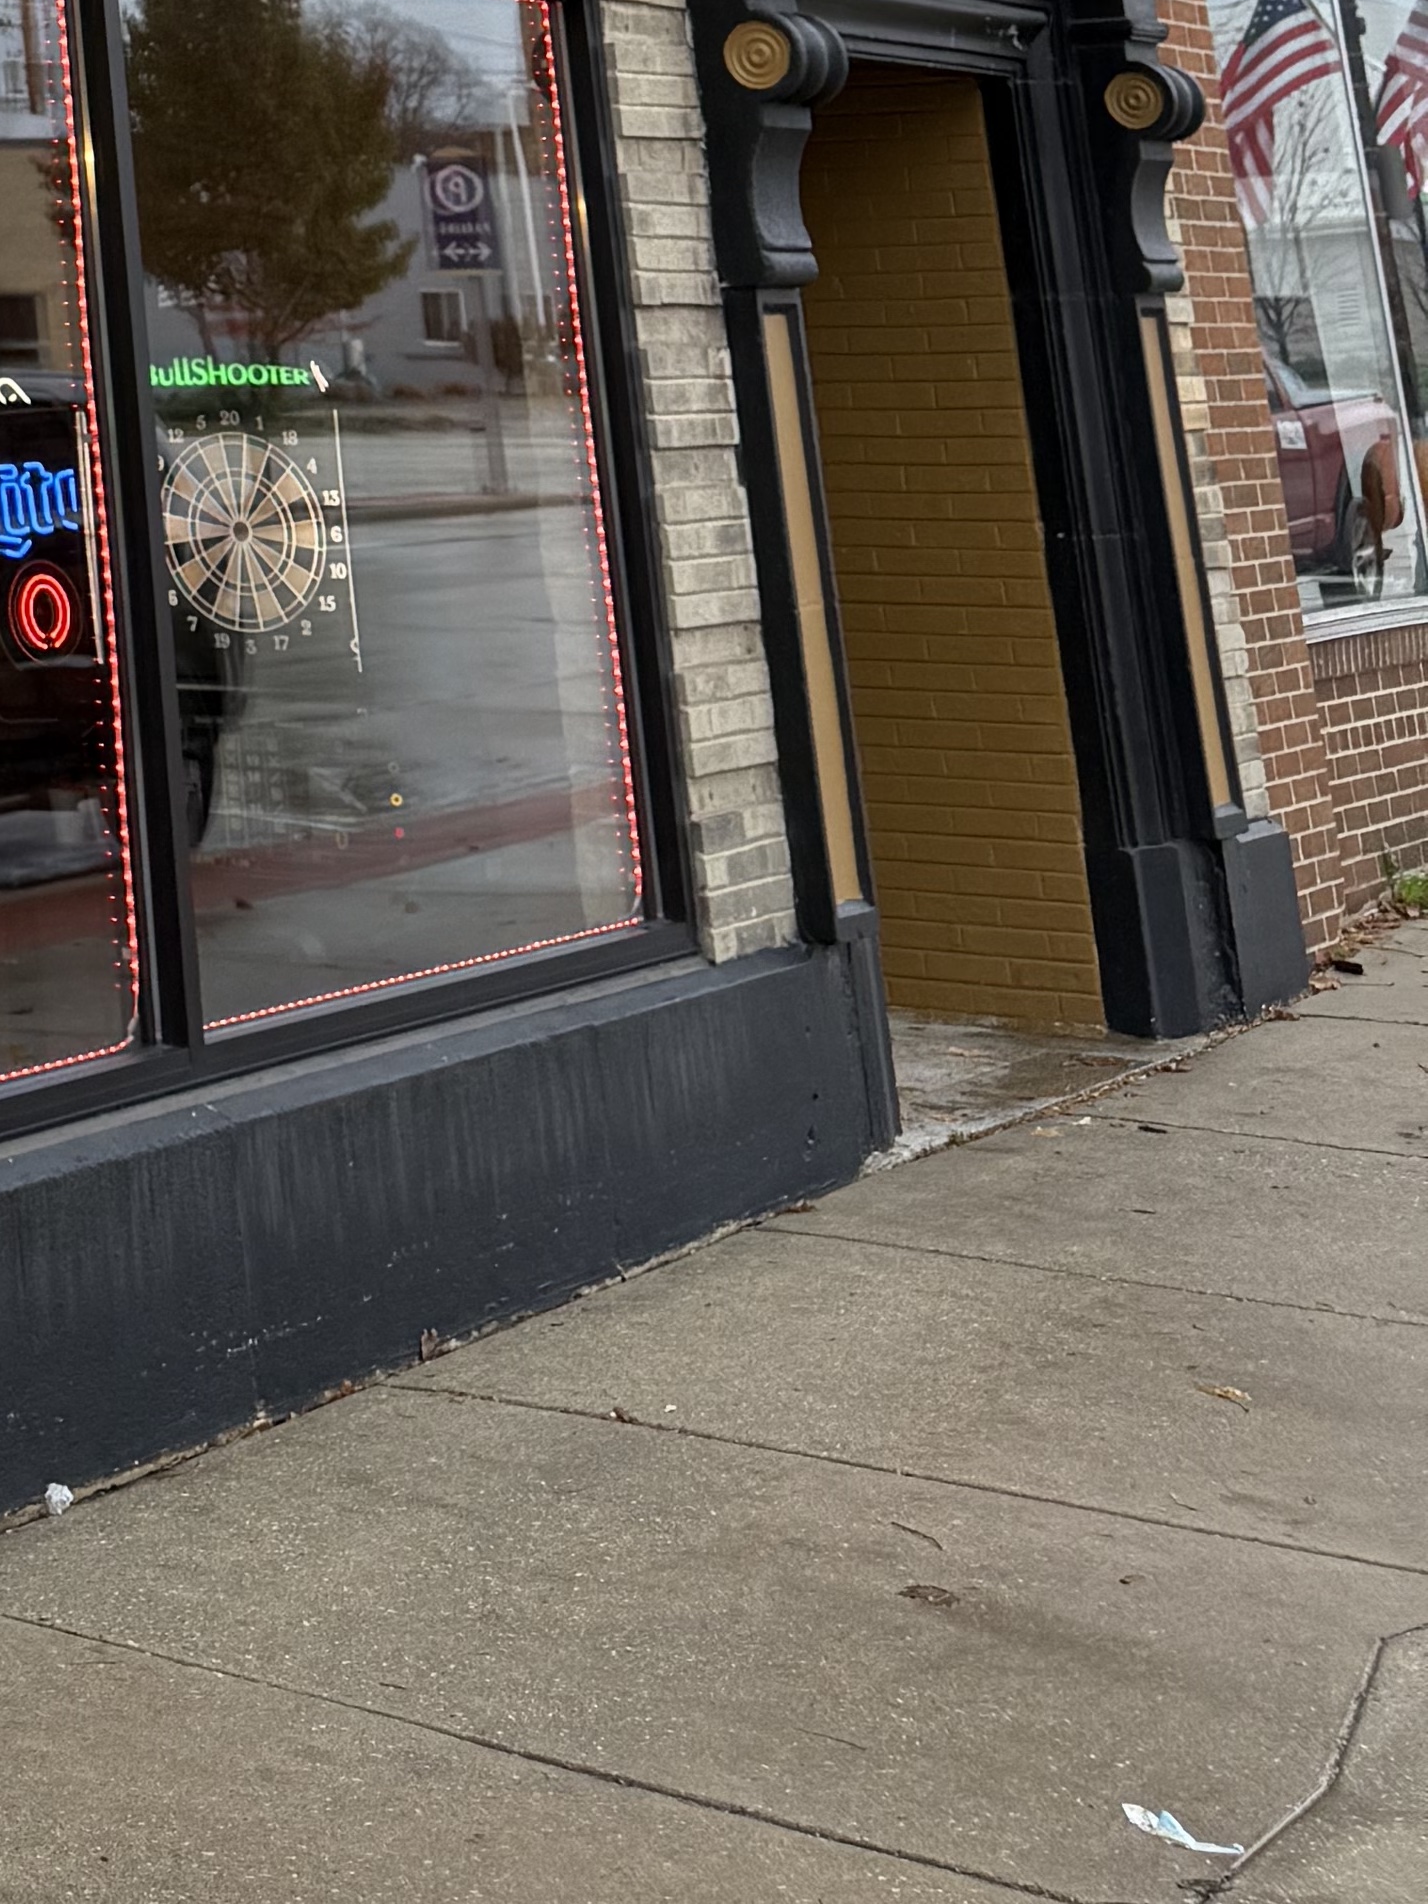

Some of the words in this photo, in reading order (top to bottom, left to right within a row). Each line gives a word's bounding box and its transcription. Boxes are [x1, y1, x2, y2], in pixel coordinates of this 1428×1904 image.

[196, 415, 206, 430] 5
[219, 410, 240, 426] 20
[255, 415, 264, 431] 1
[168, 429, 184, 444] 12
[306, 457, 317, 474] 4
[330, 525, 342, 542] 6
[329, 562, 348, 579] 10
[319, 596, 336, 612] 15
[186, 616, 198, 632] 7
[301, 620, 312, 635] 2
[214, 633, 230, 649] 19
[273, 635, 289, 651] 17
